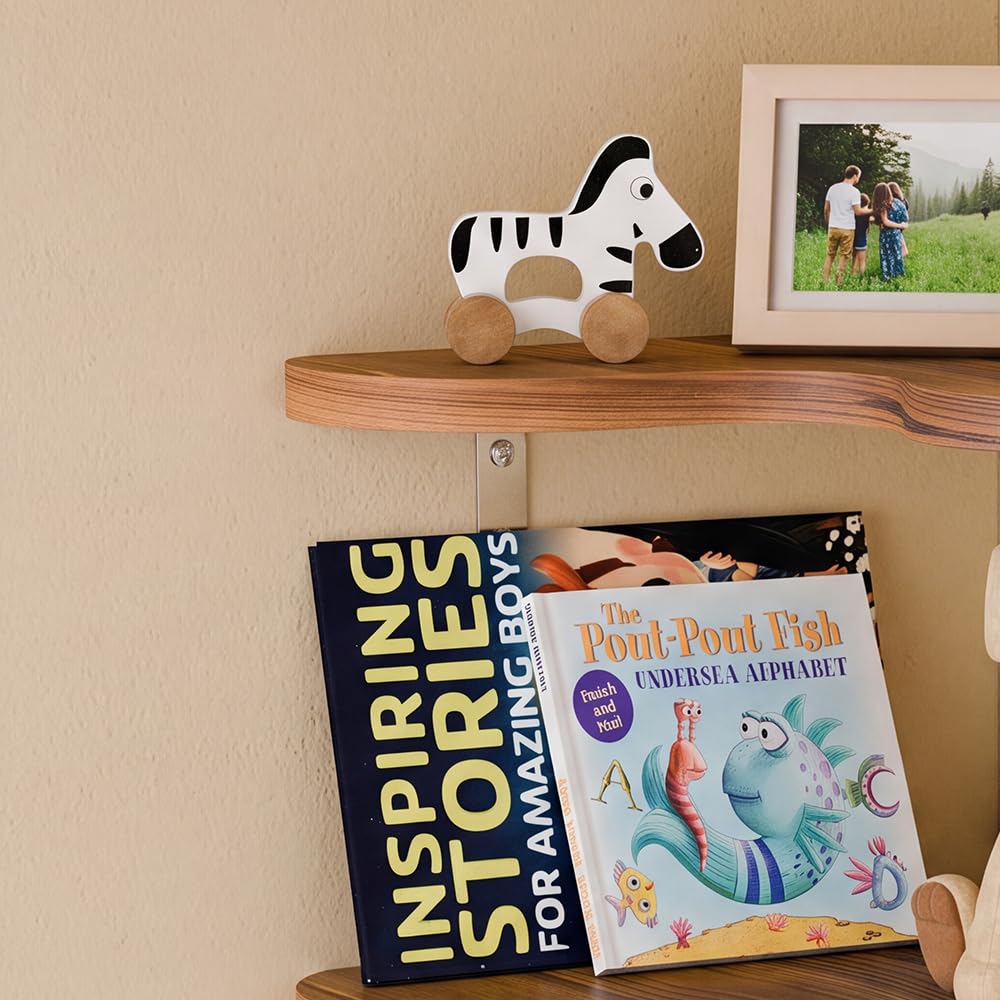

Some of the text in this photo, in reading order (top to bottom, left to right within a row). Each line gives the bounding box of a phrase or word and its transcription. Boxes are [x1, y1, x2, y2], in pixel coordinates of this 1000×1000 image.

[487, 532, 528, 645] BOYS
[601, 602, 642, 625] The
[574, 614, 762, 664] Pout-Pout
[763, 609, 844, 653] Fish
[635, 664, 740, 690] UNDERSEA
[411, 535, 530, 958] STORIES
[593, 699, 617, 717] and
[349, 542, 454, 964] INSPIRING
[503, 656, 557, 857] AMAZING
[531, 869, 570, 952] FOR
